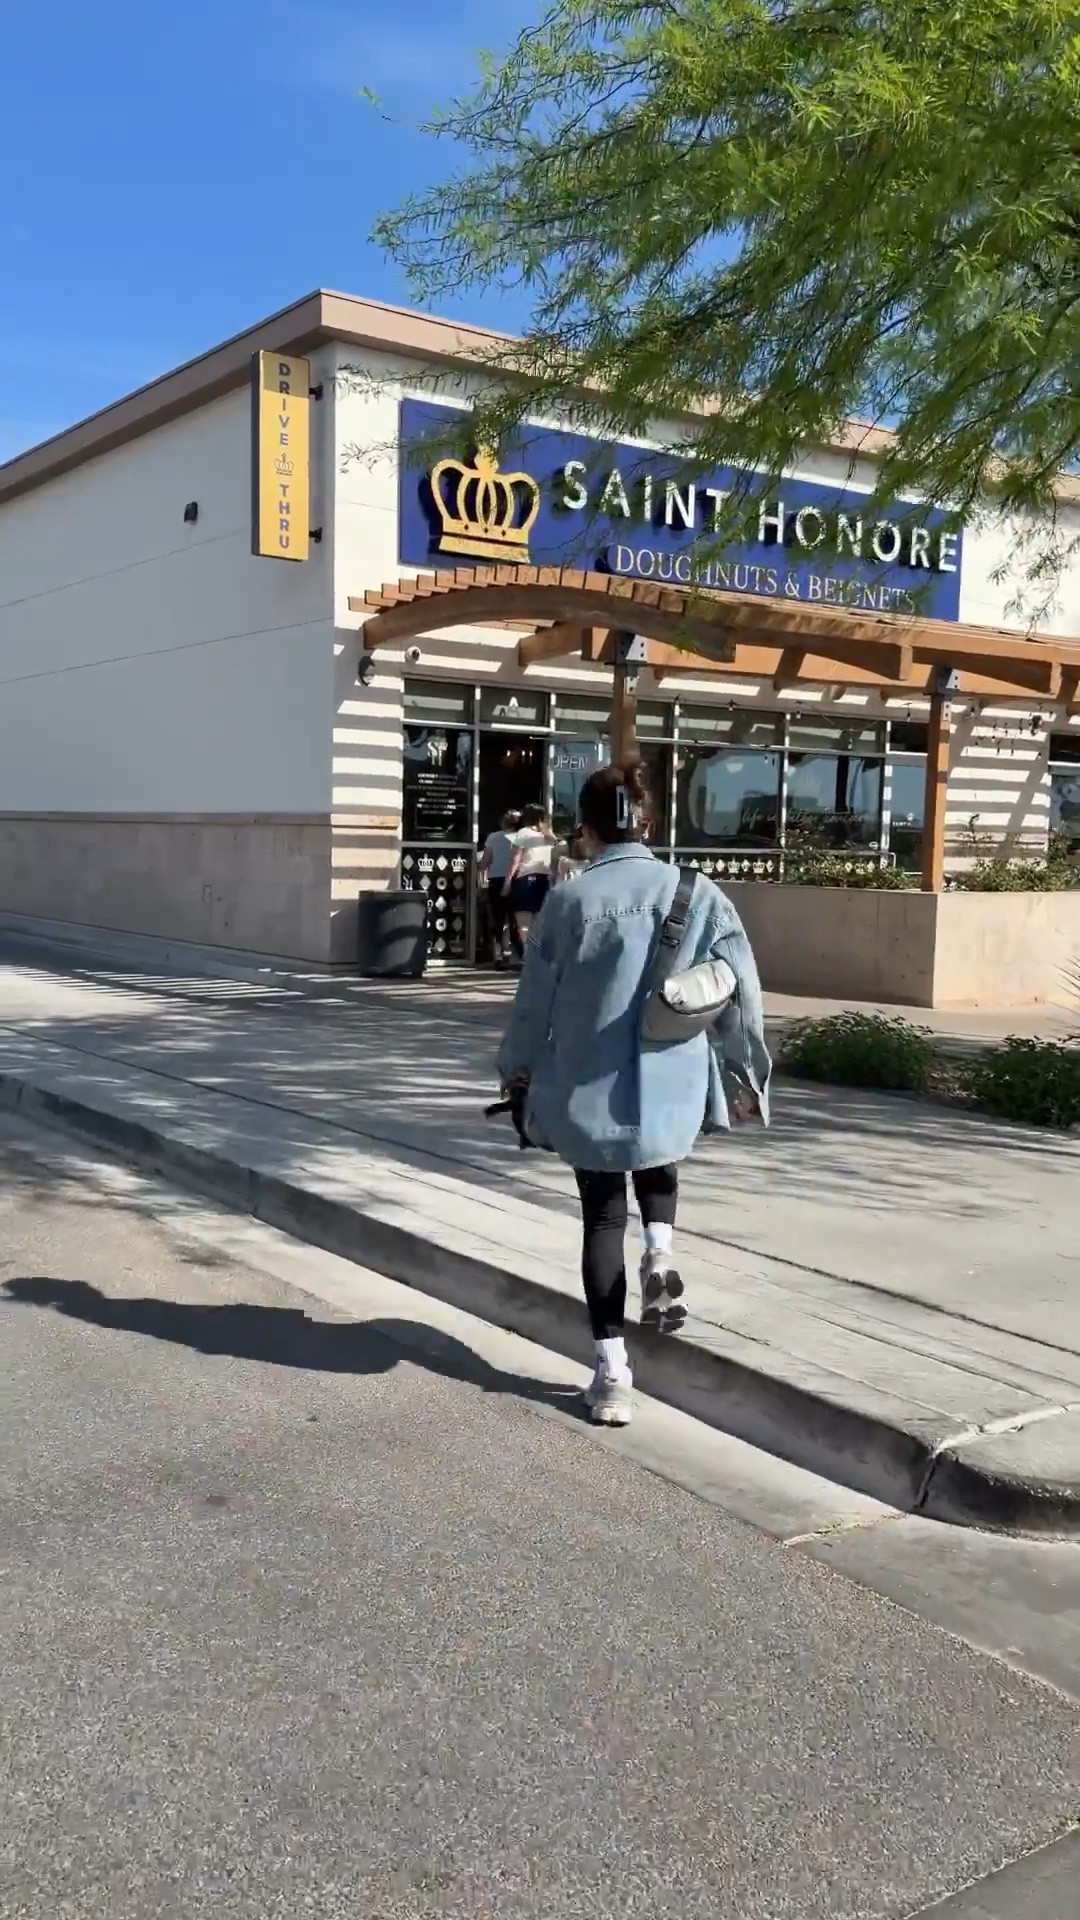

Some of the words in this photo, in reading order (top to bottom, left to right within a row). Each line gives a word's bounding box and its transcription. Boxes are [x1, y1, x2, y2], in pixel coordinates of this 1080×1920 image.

[278, 362, 291, 446] DRIVE
[278, 483, 290, 549] THRU
[562, 460, 733, 533] SAINT
[758, 497, 958, 573] HONORE
[615, 544, 778, 594] DOUGHNUTS
[784, 571, 800, 598] &
[552, 754, 588, 770] OPEN
